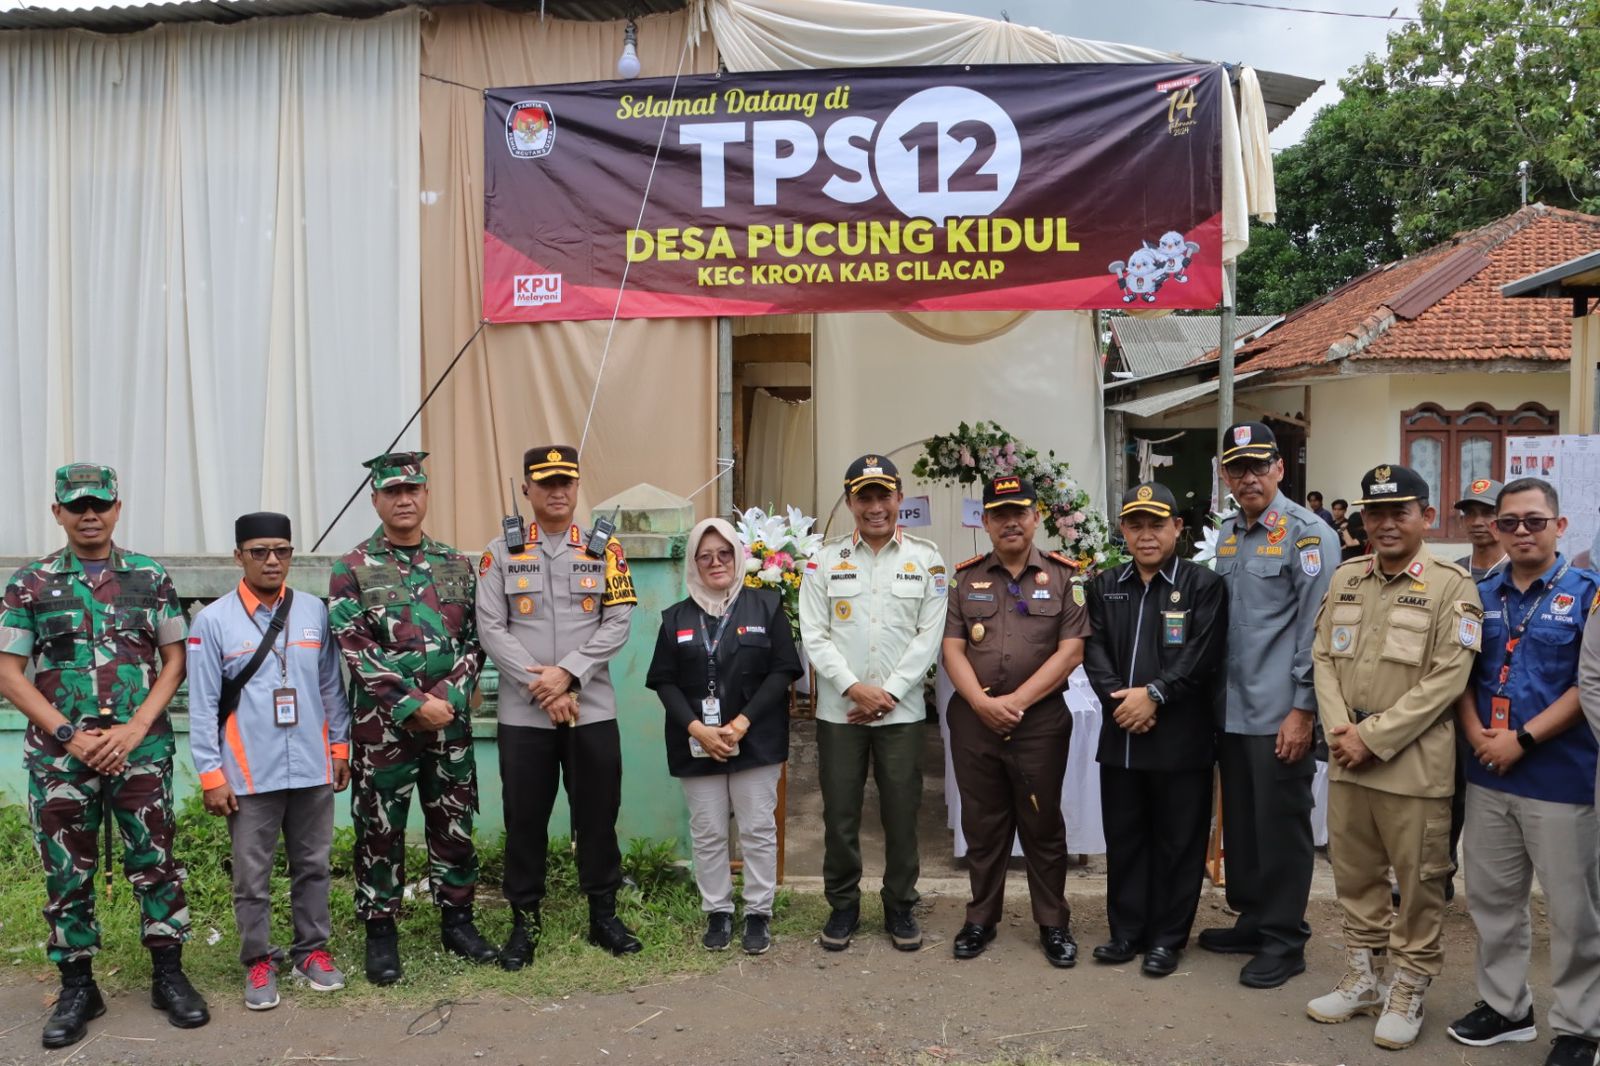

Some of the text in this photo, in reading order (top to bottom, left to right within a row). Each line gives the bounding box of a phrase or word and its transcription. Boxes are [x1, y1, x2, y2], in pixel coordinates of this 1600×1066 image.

[616, 86, 851, 120] Selamat Datang di
[1166, 88, 1198, 123] 14
[679, 115, 998, 208] TPS 12
[625, 217, 1080, 263] DESA PUCUNG KIDUL
[698, 259, 1005, 286] KEC KROYA KAB CILACAP
[517, 277, 558, 292] KPU
[517, 292, 558, 302] Melayani
[898, 508, 920, 519] TPS
[508, 564, 540, 573] RURUH
[1397, 596, 1427, 607] CAMAT
